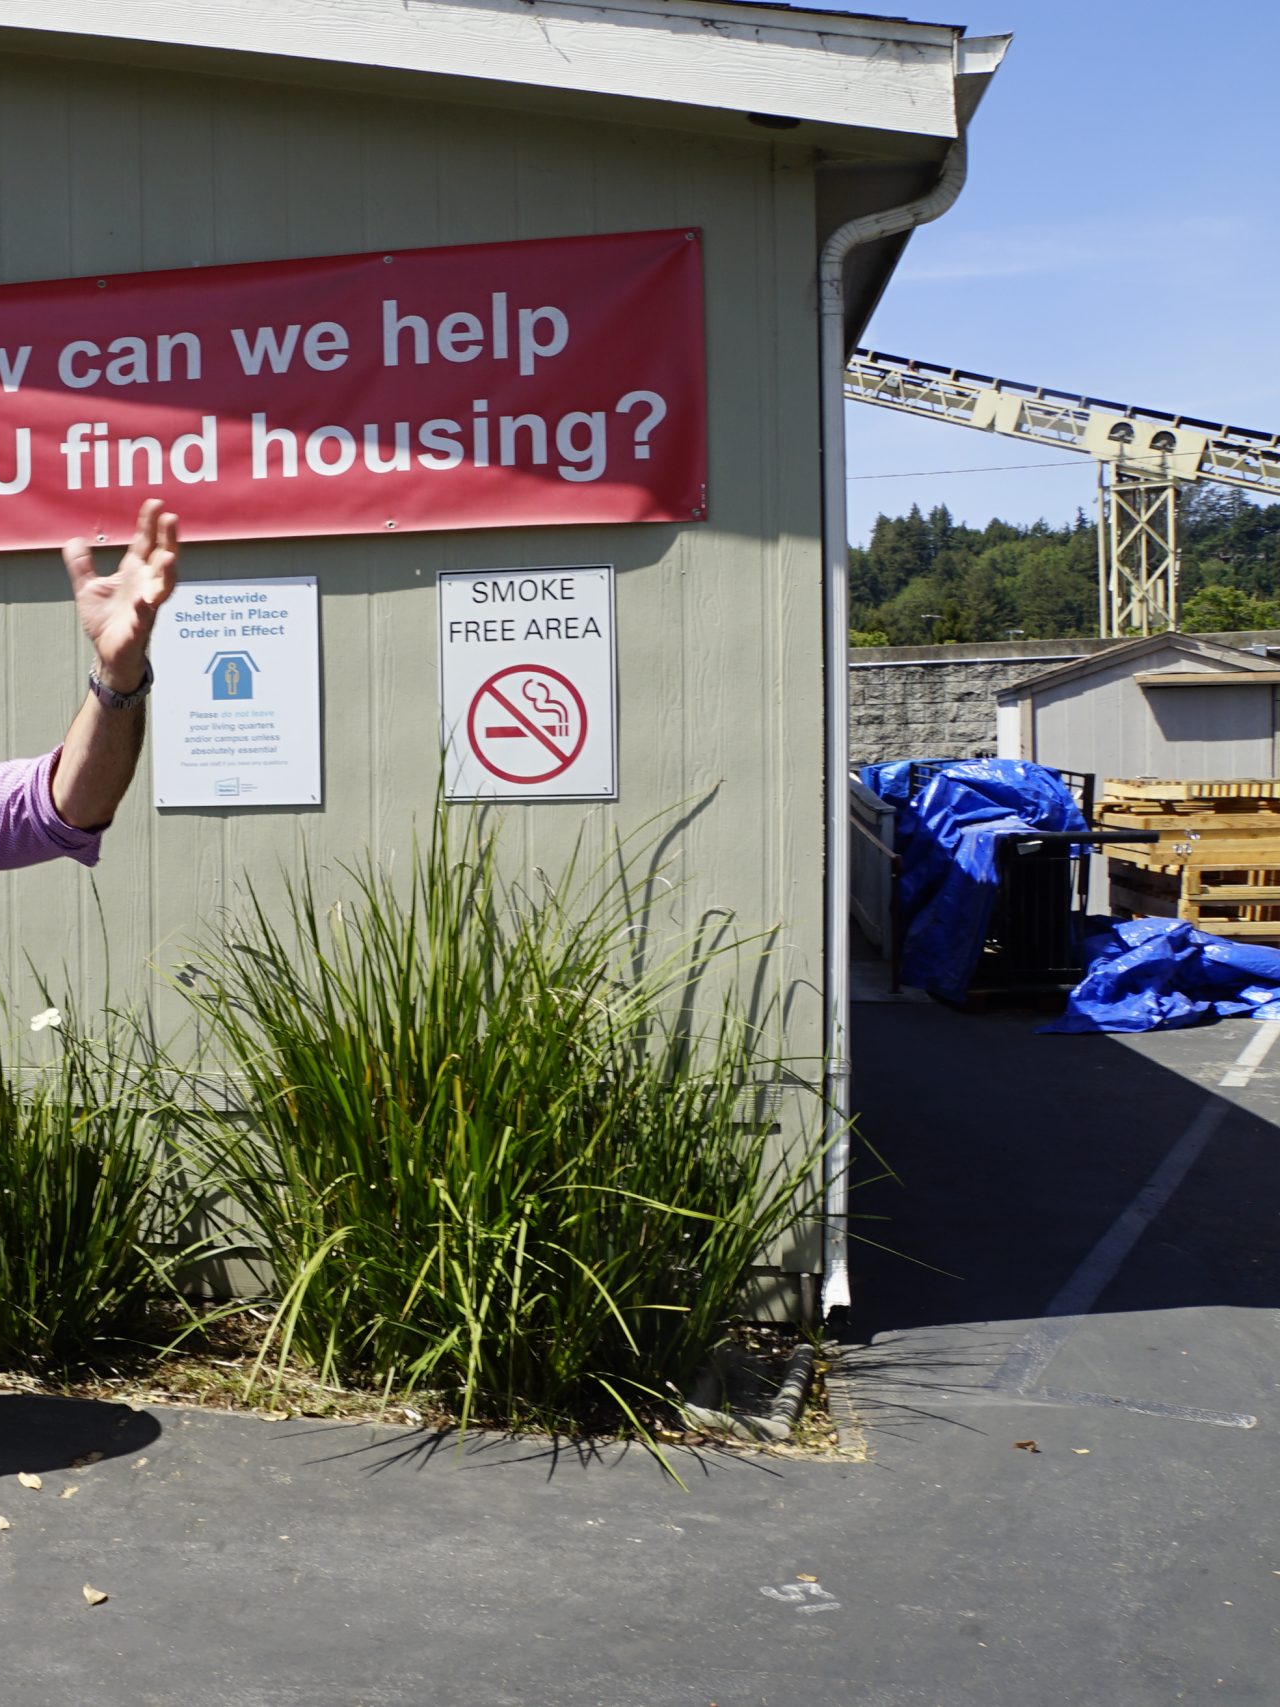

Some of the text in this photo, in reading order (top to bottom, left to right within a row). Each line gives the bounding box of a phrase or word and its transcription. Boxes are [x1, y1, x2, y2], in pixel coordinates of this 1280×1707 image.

[58, 331, 202, 388] can
[230, 320, 349, 375] we
[383, 291, 569, 376] help
[61, 414, 217, 490] find
[252, 390, 667, 482] housing?
[472, 578, 575, 604] SMOKE
[194, 592, 268, 605] Statewide
[175, 608, 288, 622] Shelter in Place
[179, 625, 285, 639] Order in Effect
[450, 617, 602, 643] FREE AREA
[189, 711, 218, 719] Please
[189, 722, 275, 732] your living quarters
[214, 735, 249, 743] campus
[251, 734, 280, 742] unless
[191, 746, 277, 756] absolutely essential
